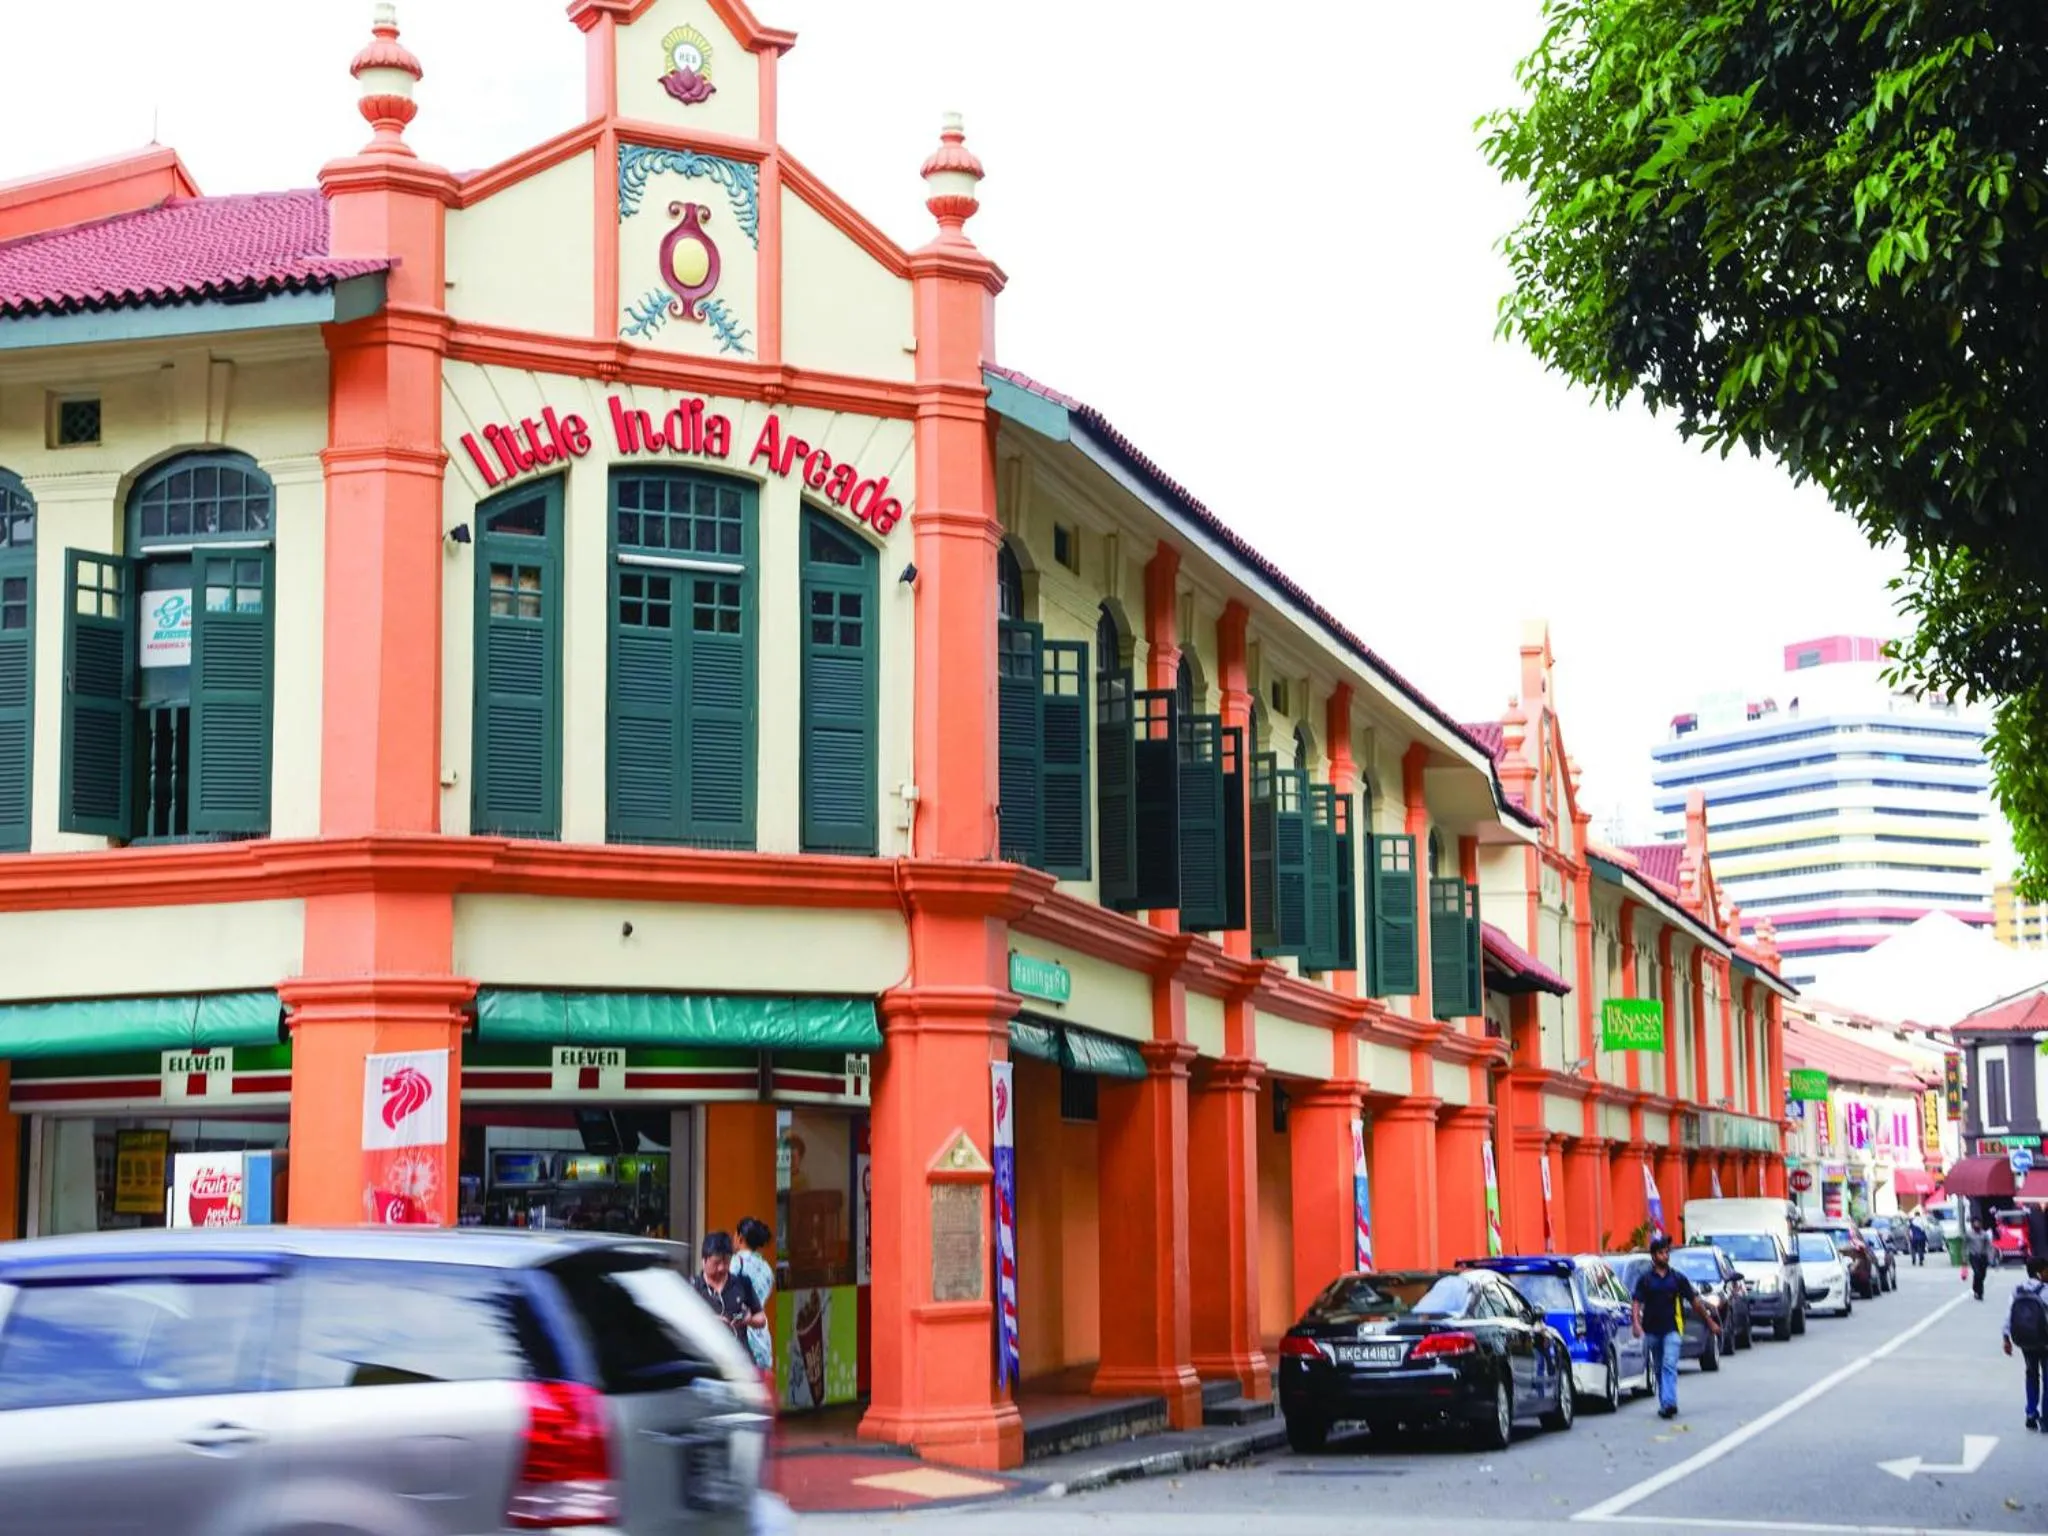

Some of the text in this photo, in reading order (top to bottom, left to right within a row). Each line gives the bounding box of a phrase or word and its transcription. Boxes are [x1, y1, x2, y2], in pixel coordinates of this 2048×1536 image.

[460, 395, 902, 535] Little India Arcade
